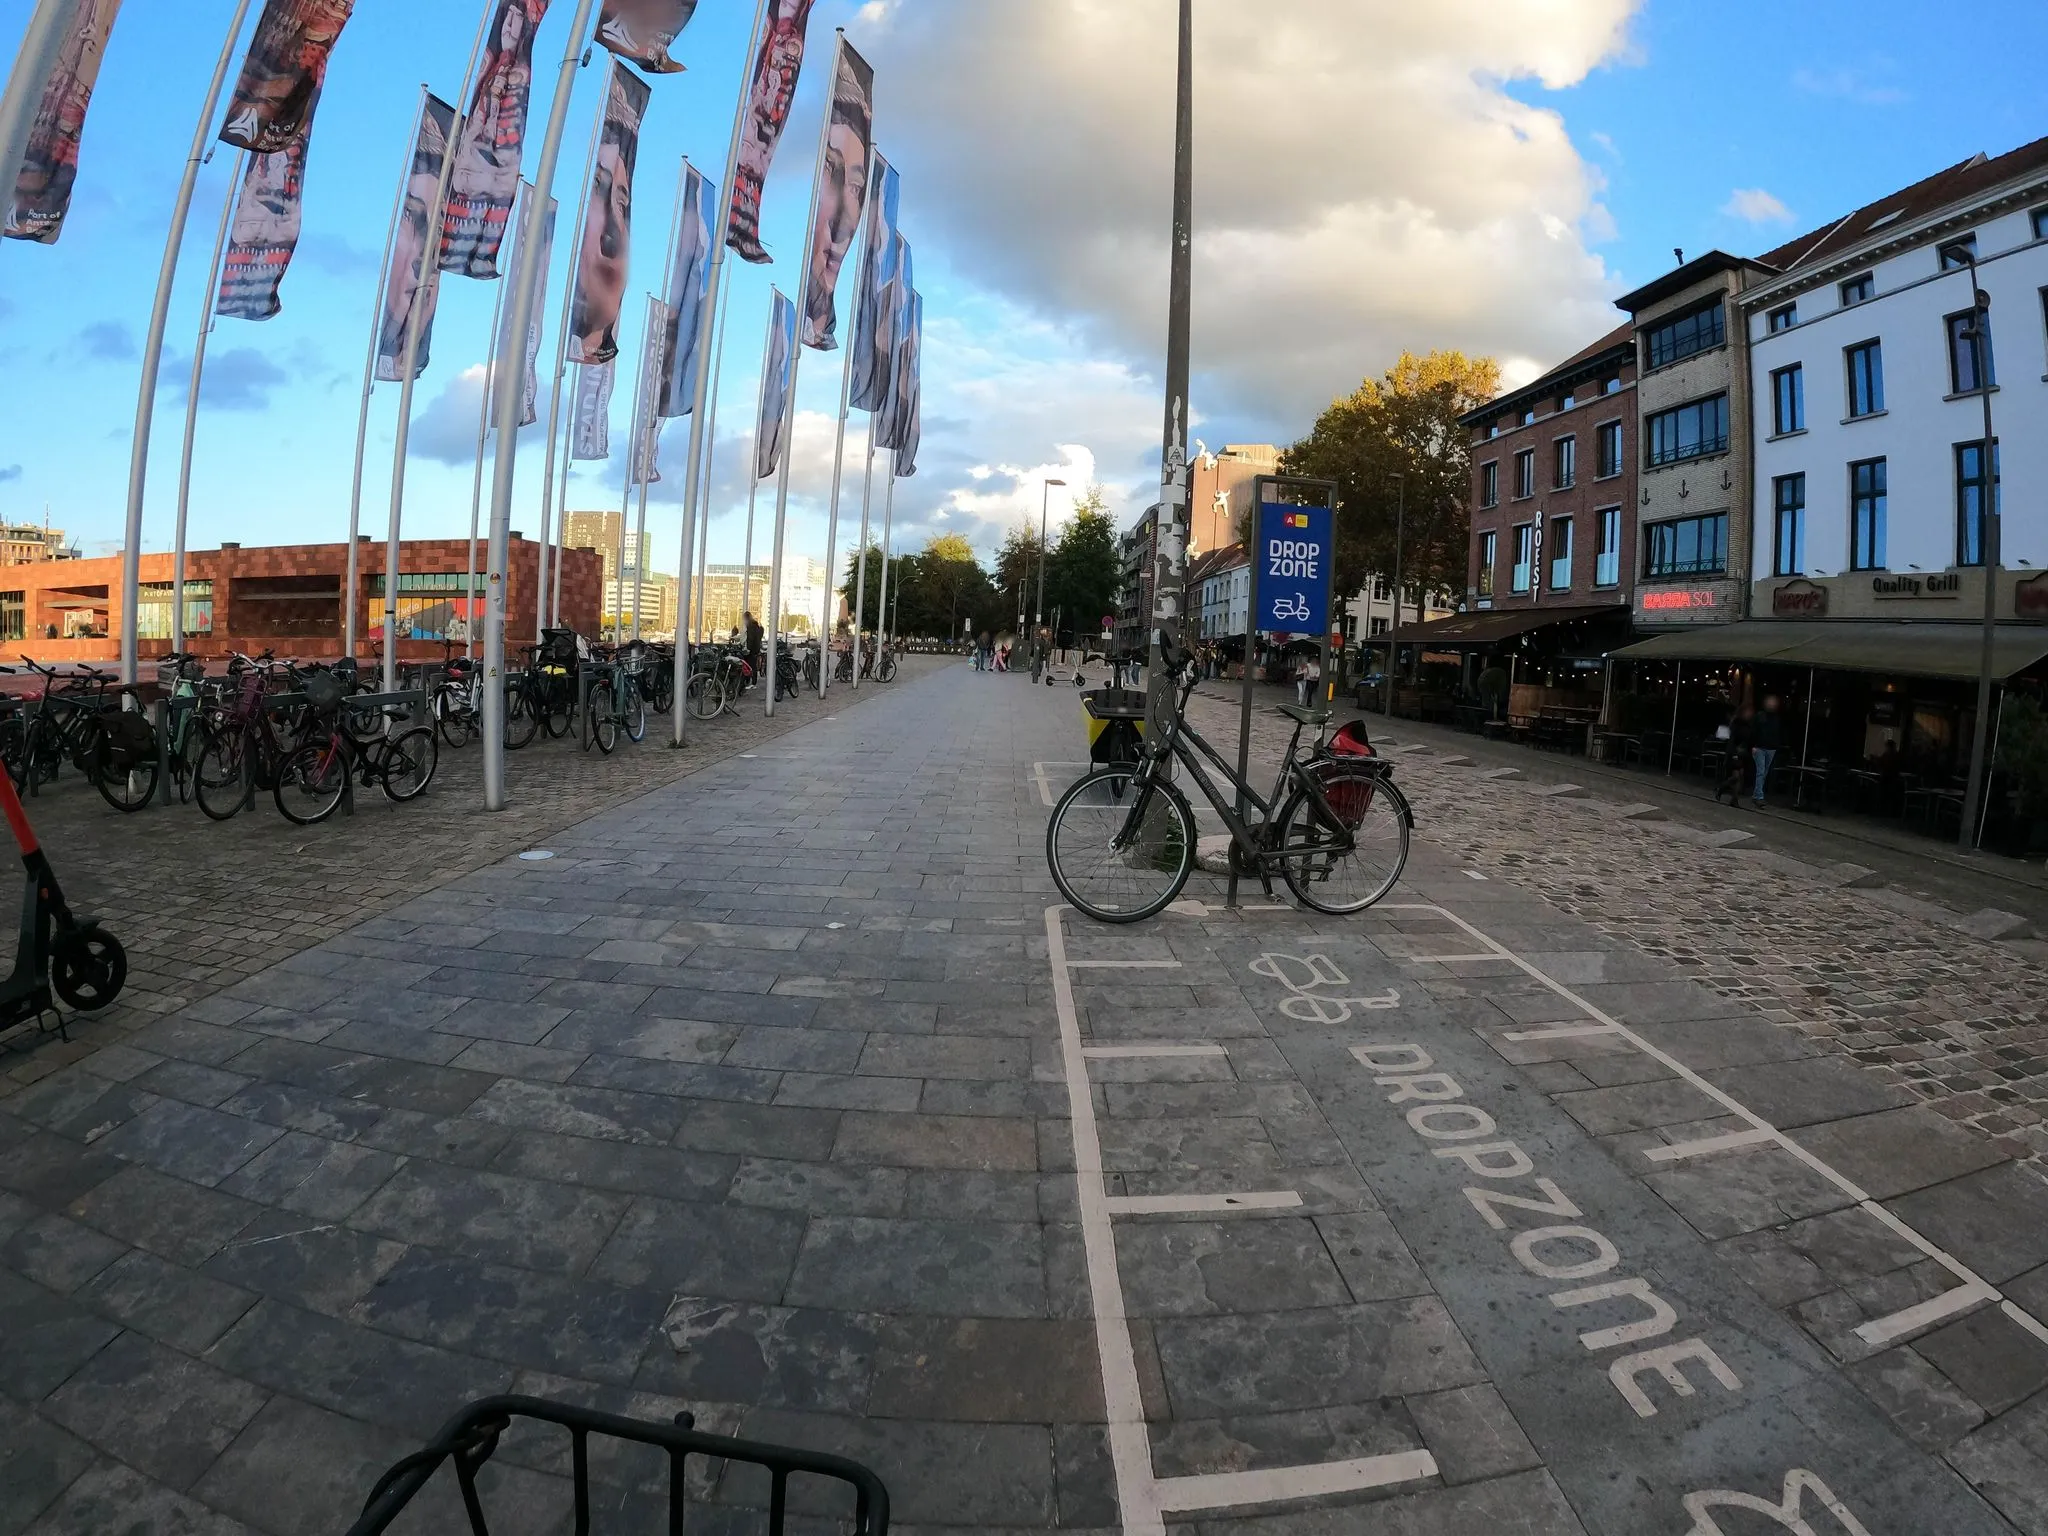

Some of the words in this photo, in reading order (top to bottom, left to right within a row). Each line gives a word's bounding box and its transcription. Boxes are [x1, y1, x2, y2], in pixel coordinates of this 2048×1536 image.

[27, 208, 47, 219] Port
[49, 211, 61, 219] of
[579, 393, 597, 456] STAD
[1286, 516, 1294, 524] A
[1269, 539, 1320, 560] DROP
[1532, 510, 1542, 602] ROEST
[1872, 576, 1921, 595] Quality
[1927, 574, 1959, 592] Grill
[1693, 591, 1716, 607] SOL
